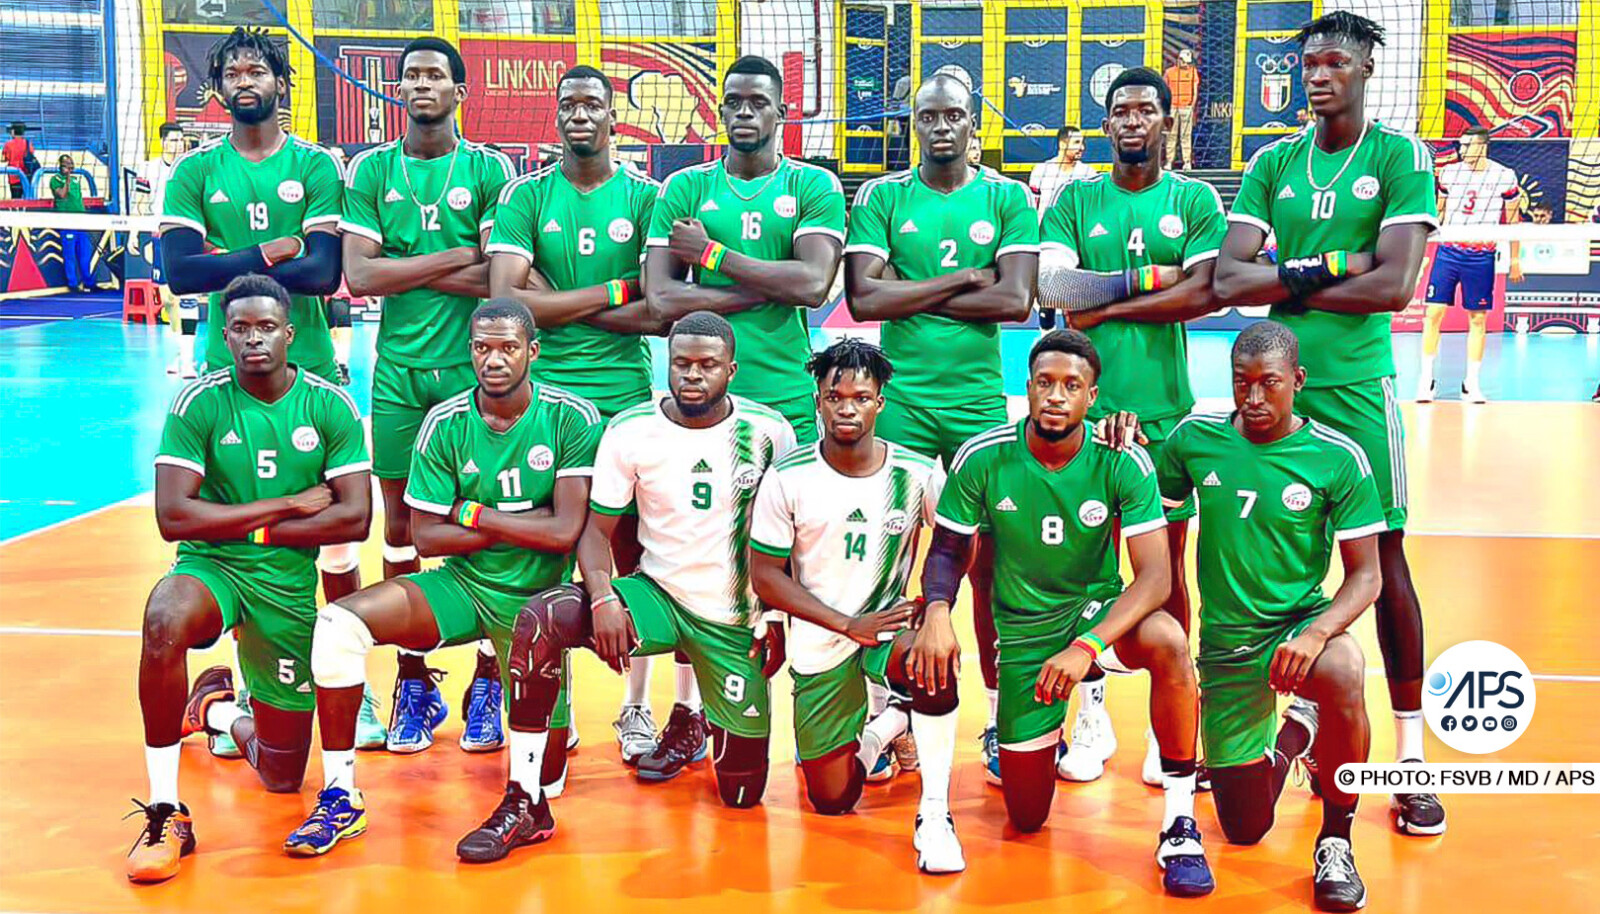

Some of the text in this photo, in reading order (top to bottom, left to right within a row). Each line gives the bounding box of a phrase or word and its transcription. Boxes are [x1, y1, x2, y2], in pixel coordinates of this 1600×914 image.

[1311, 190, 1336, 219] 10
[1464, 190, 1477, 211] 3
[246, 202, 269, 230] 19
[420, 204, 441, 230] 12
[741, 211, 762, 239] 16
[579, 228, 596, 255] 6
[939, 239, 959, 267] 2
[1127, 228, 1145, 256] 4
[257, 450, 277, 478] 5
[497, 467, 522, 497] 11
[692, 482, 712, 510] 9
[1237, 490, 1258, 518] 7
[1042, 516, 1064, 545] 8
[844, 532, 866, 561] 14
[278, 658, 295, 684] 5
[724, 674, 745, 702] 9
